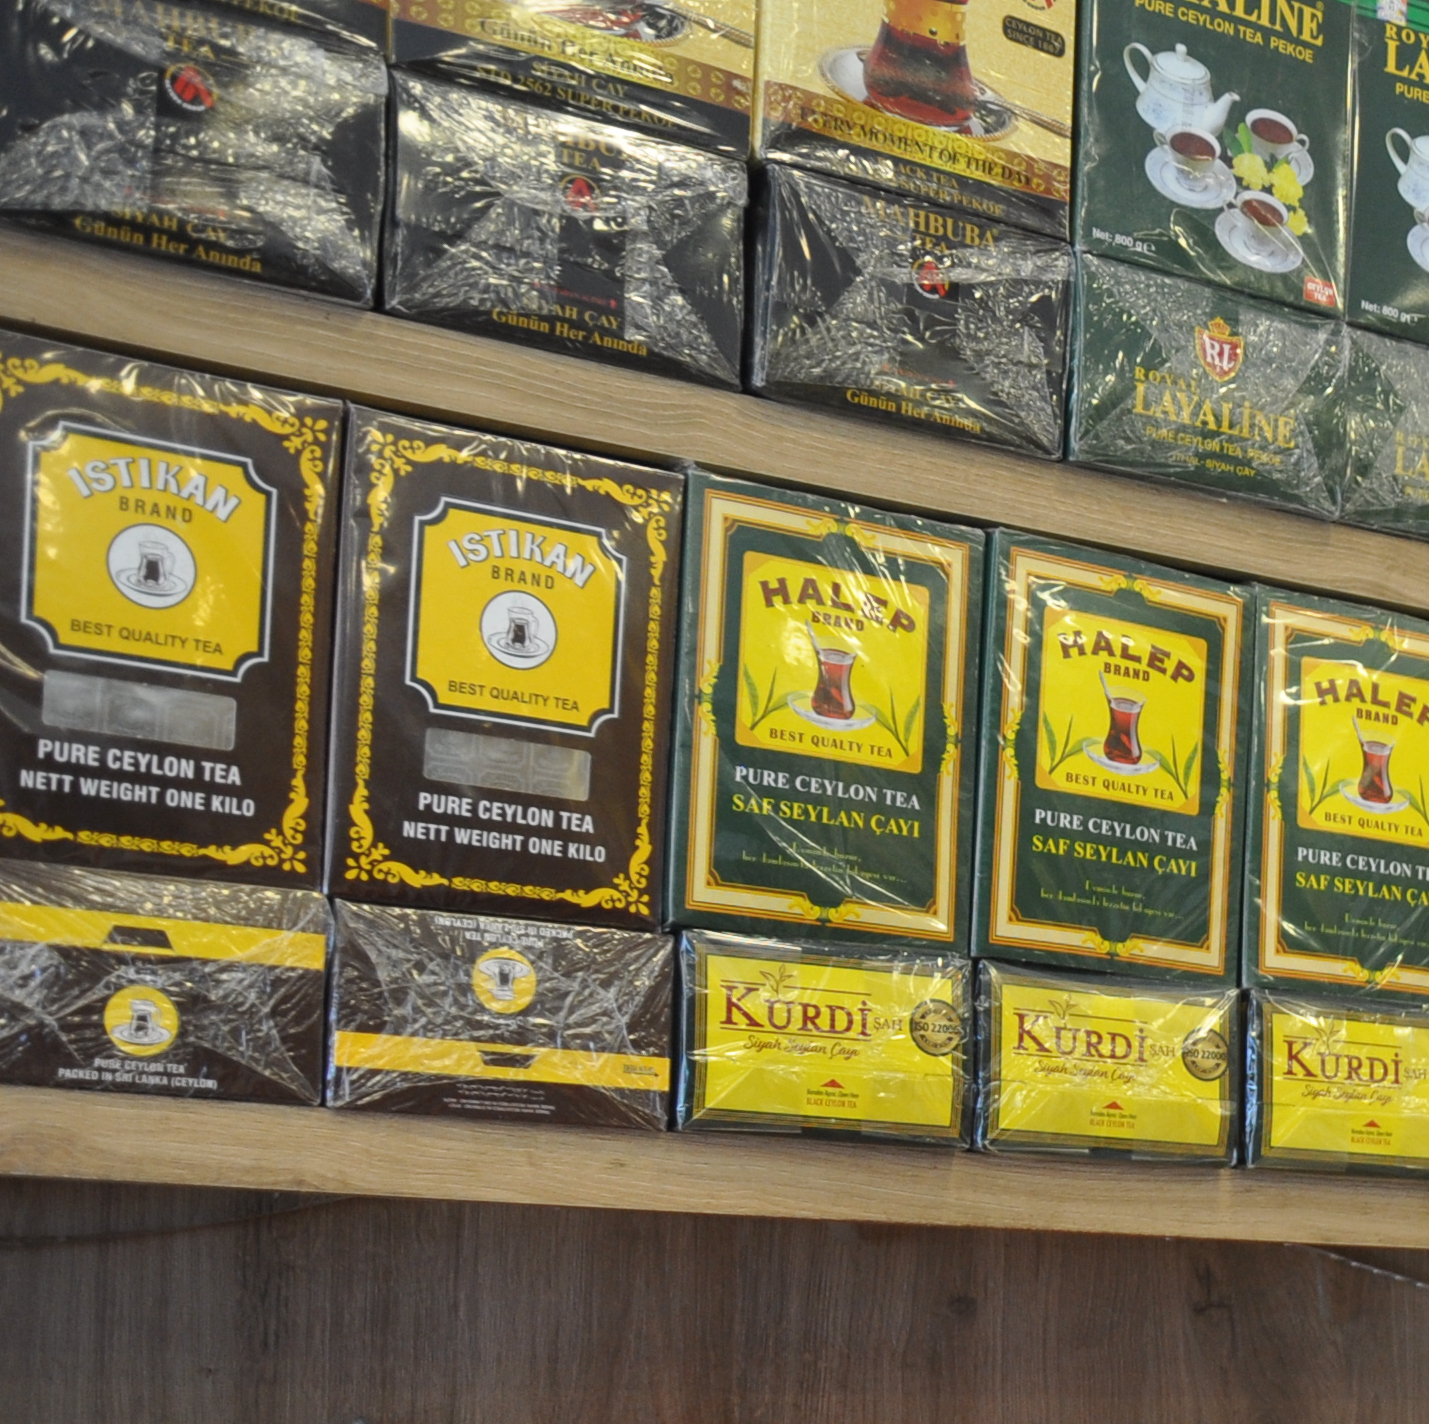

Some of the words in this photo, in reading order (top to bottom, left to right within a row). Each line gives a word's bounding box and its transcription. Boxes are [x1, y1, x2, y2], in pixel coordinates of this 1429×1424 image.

[1135, 0, 1175, 19] PURE
[1177, 7, 1235, 36] CEYLON
[1238, 26, 1264, 46] TEA
[1270, 38, 1314, 63] PEKOE
[562, 149, 601, 172] TEA
[863, 195, 998, 250] MAHBUBA
[74, 215, 144, 246] Günün
[152, 233, 188, 256] Her
[194, 245, 262, 273] Anında
[492, 306, 550, 332] Günün
[554, 322, 587, 342] Her
[591, 331, 648, 357] Anında
[1203, 334, 1235, 368] RL
[1135, 366, 1197, 392] ROYAL
[1133, 382, 1295, 448] LAYALİNE
[66, 455, 242, 523] ISTIKAN
[118, 495, 194, 525] BRAND
[446, 527, 597, 589] ISTIKAN
[490, 564, 556, 590] BRAND
[758, 575, 917, 634] HALEP
[811, 610, 865, 632] BRAND
[69, 618, 113, 637] BEST
[118, 625, 188, 651] QUALITY
[191, 638, 225, 657] TEA
[1058, 629, 1196, 685] HALEP
[1103, 662, 1151, 682] BRAND
[448, 679, 484, 698] BEST
[489, 684, 550, 709] QUALITY
[555, 696, 580, 714] TEA
[1355, 707, 1399, 726] BRAND
[769, 727, 805, 745] BEST
[810, 734, 864, 755] QUALTY
[868, 743, 894, 759] TEA
[37, 737, 100, 767] PURE
[106, 748, 195, 780] CEYLON
[201, 761, 242, 786] TEA
[19, 768, 74, 793] NETT
[79, 776, 159, 805] WEIGHT
[165, 787, 206, 811] ONE
[211, 794, 255, 818] KILO
[734, 764, 790, 790] PURE
[794, 774, 879, 804] CEYLON
[882, 788, 920, 811] TEA
[1065, 771, 1098, 787] BEST
[1102, 778, 1150, 798] QUALTY
[1153, 787, 1175, 802] TEA
[418, 791, 472, 819] PURE
[477, 801, 554, 828] CEYLON
[558, 811, 595, 834] TEA
[732, 793, 774, 814] SAF
[778, 801, 865, 830] SEYLAN
[869, 814, 920, 838] ÇAYI
[1324, 811, 1354, 826] BEST
[1357, 818, 1400, 834] QUALTY
[1403, 825, 1423, 838] TEA
[402, 819, 449, 842] NETT
[454, 826, 523, 853] WEIGHT
[528, 837, 563, 857] ONE
[567, 842, 606, 863] KILO
[1034, 808, 1084, 830] PURE
[1087, 816, 1160, 844] CEYLON
[1164, 829, 1198, 851] TEA
[1032, 834, 1071, 856] SAF
[1073, 841, 1149, 870] SEYLAN
[1153, 854, 1198, 877] ÇAYI
[1297, 846, 1342, 868] PURE
[1345, 854, 1412, 878] CEYLON
[1295, 871, 1330, 891] SAF
[1333, 878, 1402, 903] SEYLAN
[873, 1016, 903, 1032] ŞAH
[743, 1034, 781, 1052] Siyah
[830, 1042, 859, 1060] Çayı
[1151, 1046, 1176, 1058] ŞAH
[1200, 1051, 1227, 1061] 22000
[58, 1068, 99, 1080] PACKED
[101, 1071, 112, 1081] IN
[115, 1072, 132, 1082] SRI
[135, 1074, 168, 1085] LANKA
[171, 1078, 218, 1090] (CEYLON)
[94, 1058, 121, 1069] PURE
[124, 1060, 163, 1072] CEYLON
[166, 1063, 185, 1074] TEA
[1034, 1060, 1069, 1077] Siyah
[1404, 1067, 1427, 1081] ŞAH
[806, 1097, 823, 1106] BLACK
[824, 1099, 845, 1107] CEYLON
[1302, 1085, 1331, 1100] Siyah
